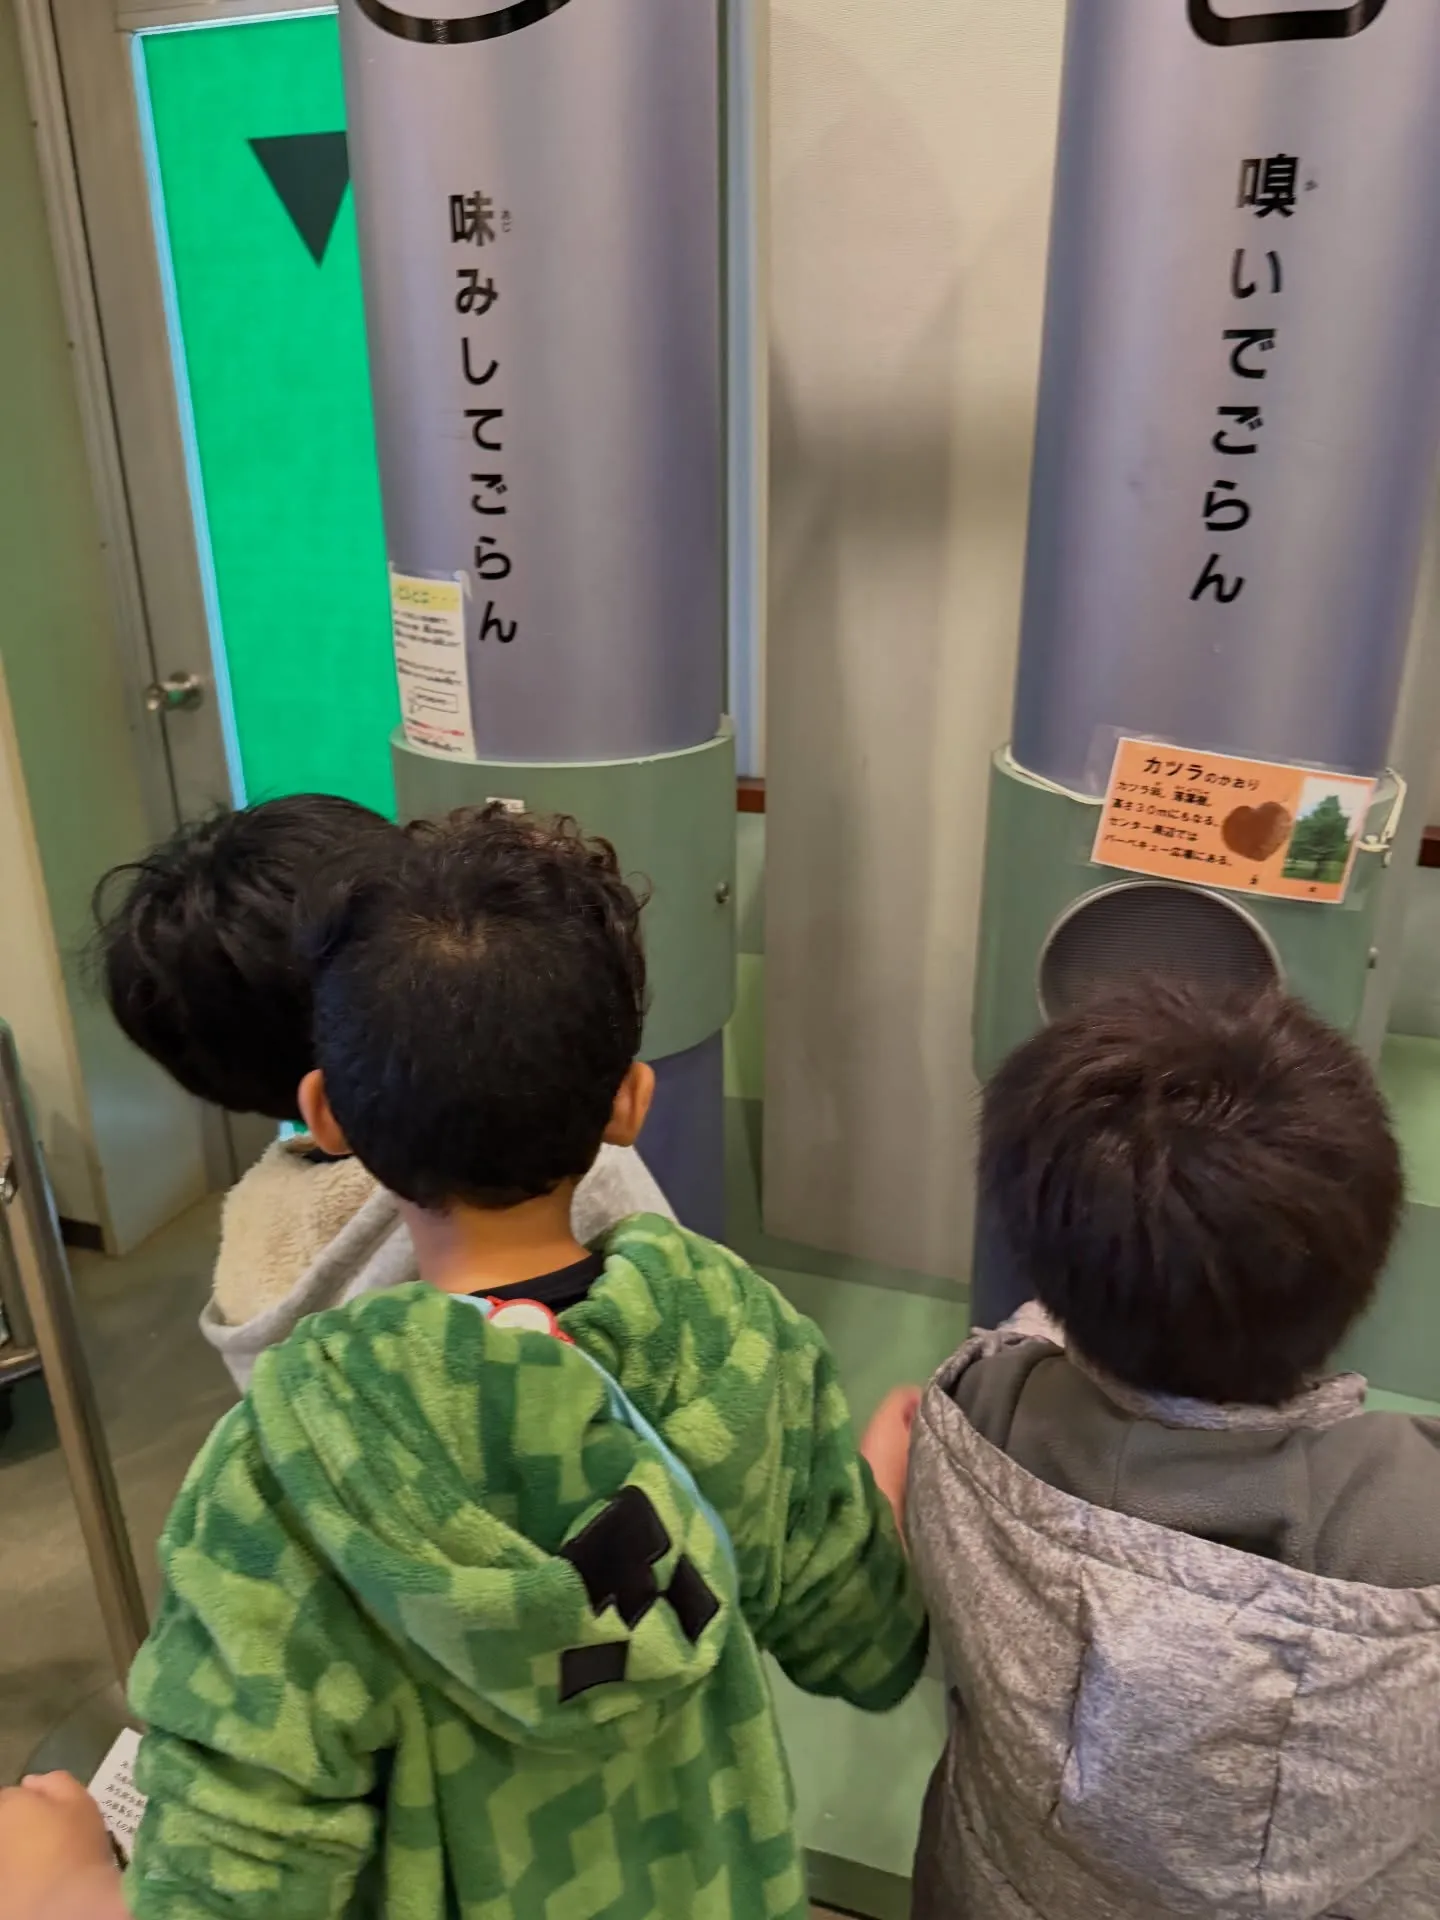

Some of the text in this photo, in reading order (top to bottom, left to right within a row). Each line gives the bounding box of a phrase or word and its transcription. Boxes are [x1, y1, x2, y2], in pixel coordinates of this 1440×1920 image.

[449, 190, 519, 644] 味みしてごらん
[1189, 153, 1300, 604] 嗅いでごらん
[1143, 757, 1260, 791] カツラのかおり
